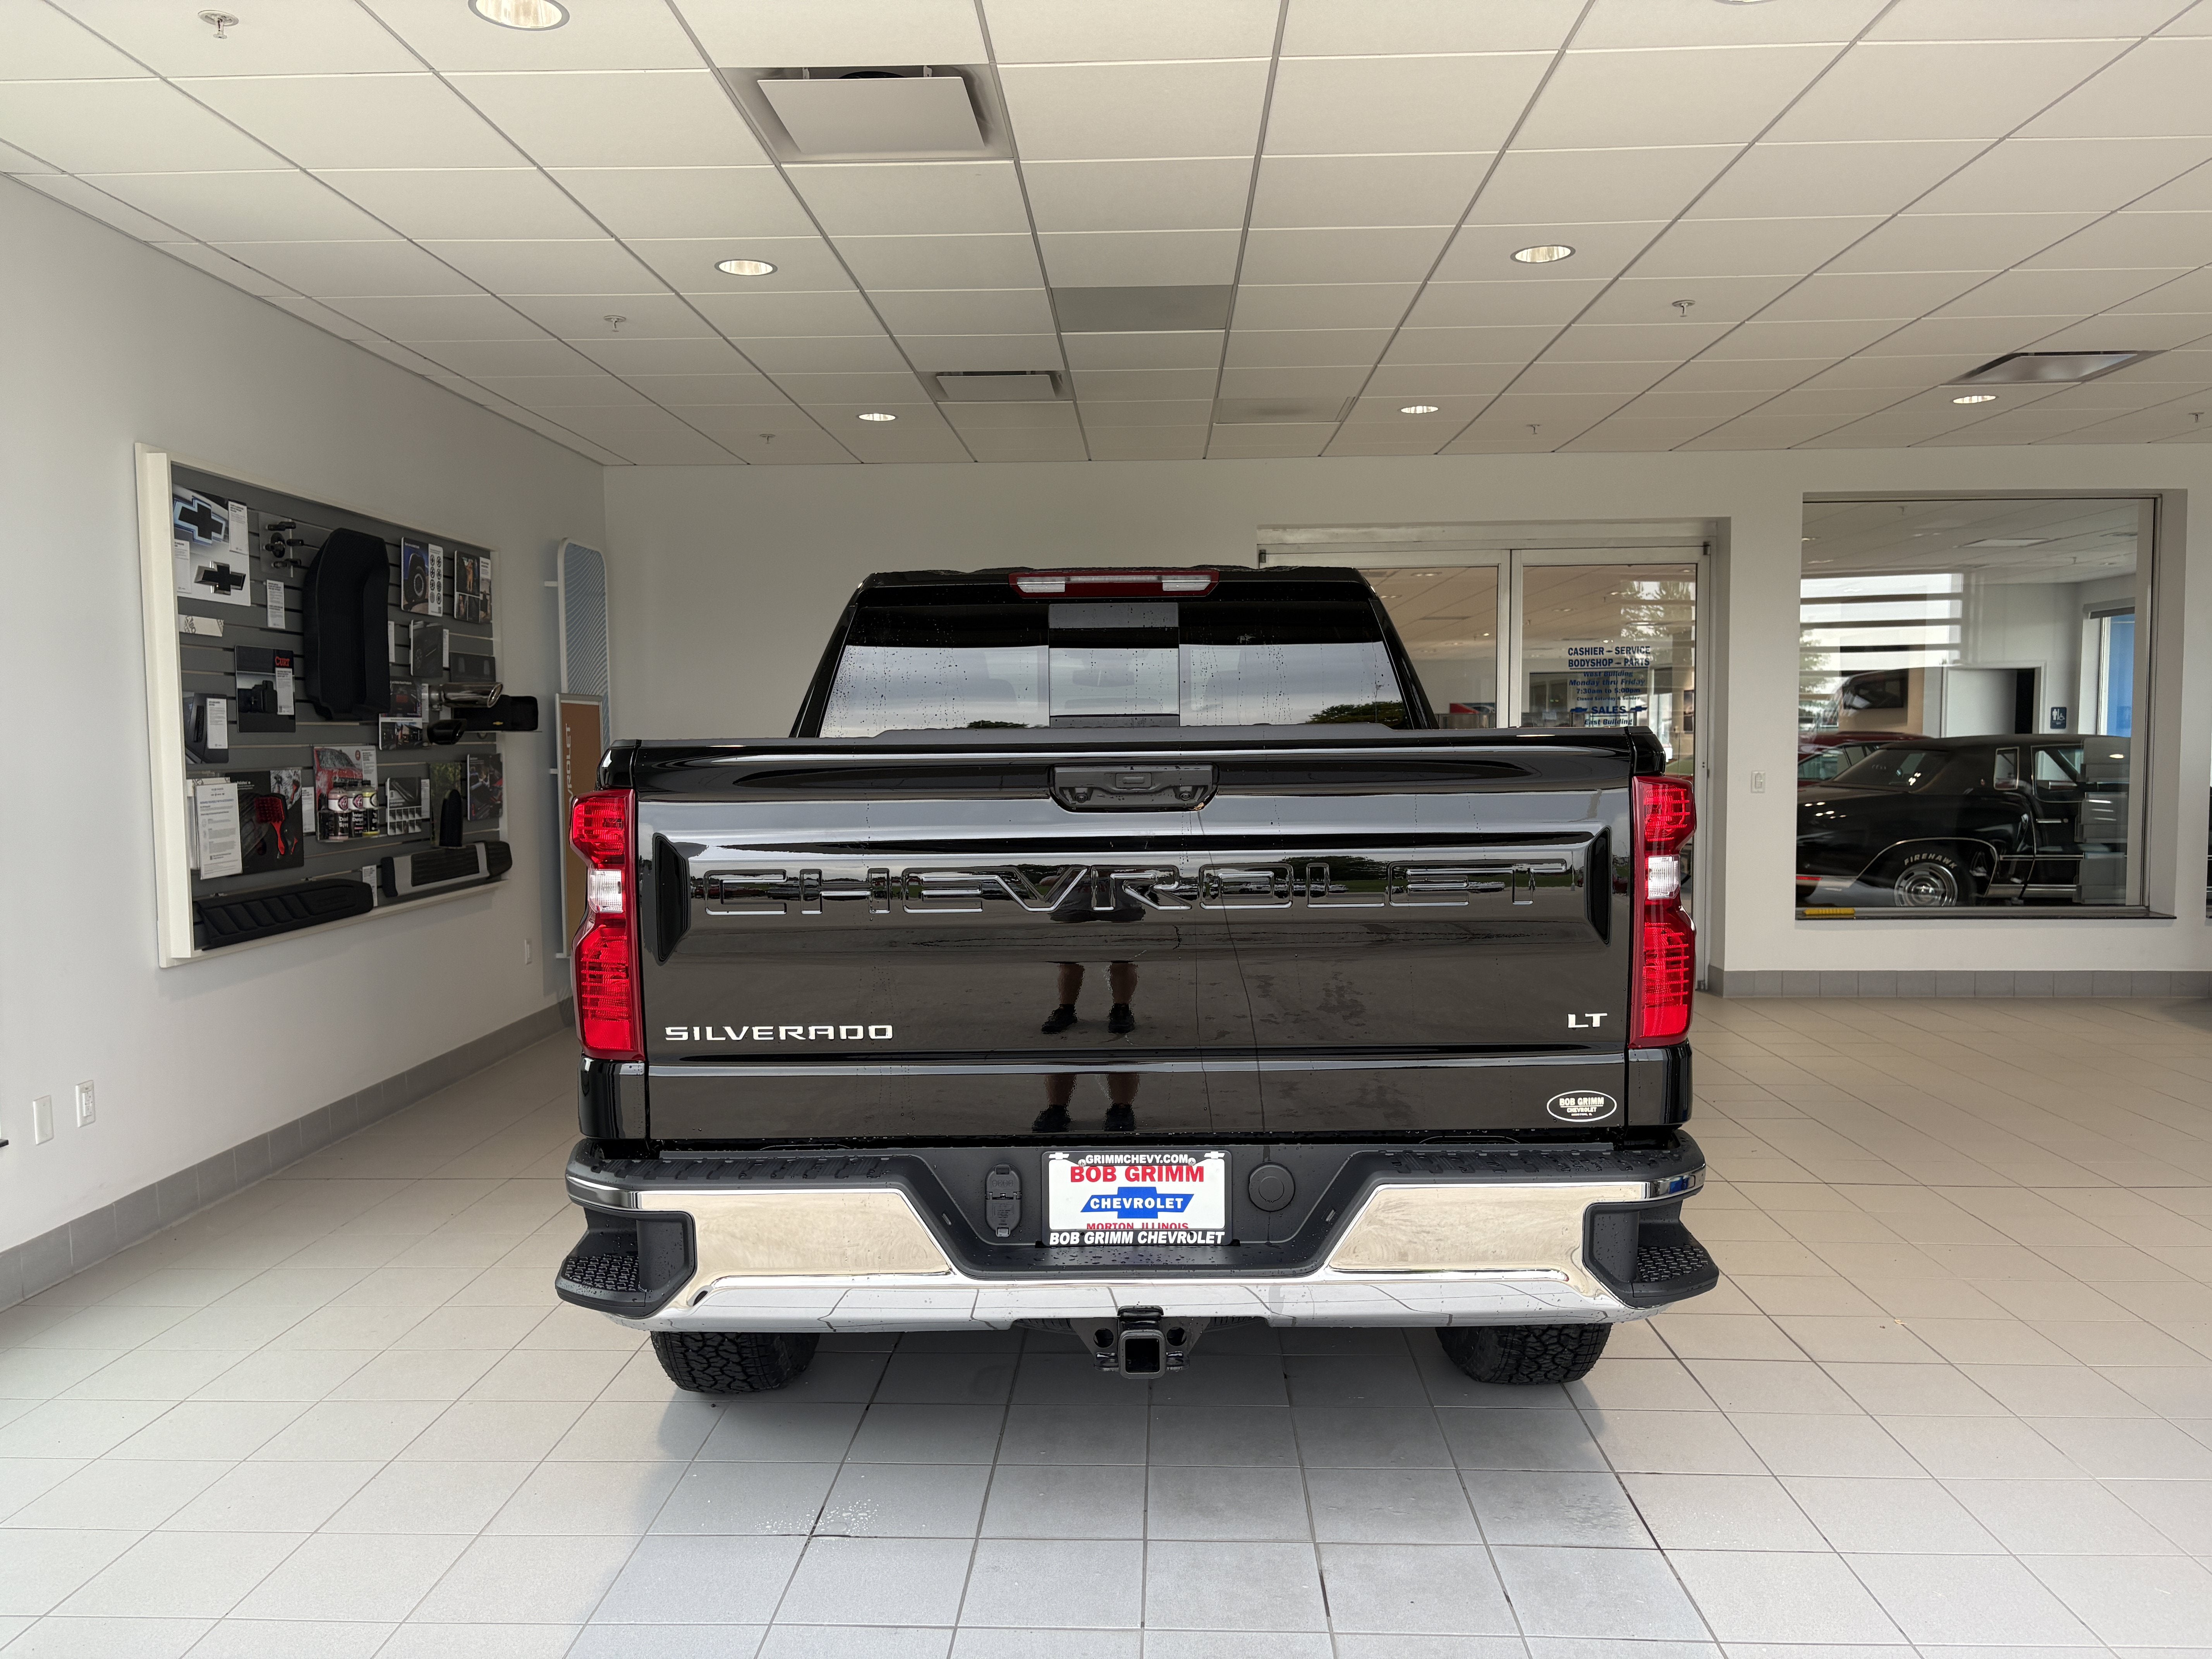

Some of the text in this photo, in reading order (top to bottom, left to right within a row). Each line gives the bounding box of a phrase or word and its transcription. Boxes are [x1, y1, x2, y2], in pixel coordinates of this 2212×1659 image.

[1568, 647, 1604, 656] CASHIER
[1615, 646, 1650, 654] SERVICE
[1568, 659, 1613, 667] BODYSHOP
[1591, 706, 1626, 714] SALES
[1904, 853, 1957, 869] FIREHAWK
[704, 858, 1567, 915] CHEVROLET
[1568, 1013, 1607, 1028] LT
[665, 1025, 893, 1041] SILVERADO
[1577, 1097, 1604, 1105] GRIMM
[1085, 1154, 1188, 1164] GRIMMCHEVY.COM
[1071, 1166, 1204, 1182] BOB GRIMM
[1090, 1198, 1183, 1209] CHEVROLET
[1049, 1231, 1225, 1245] BOB GRIMM CHEVROLET
